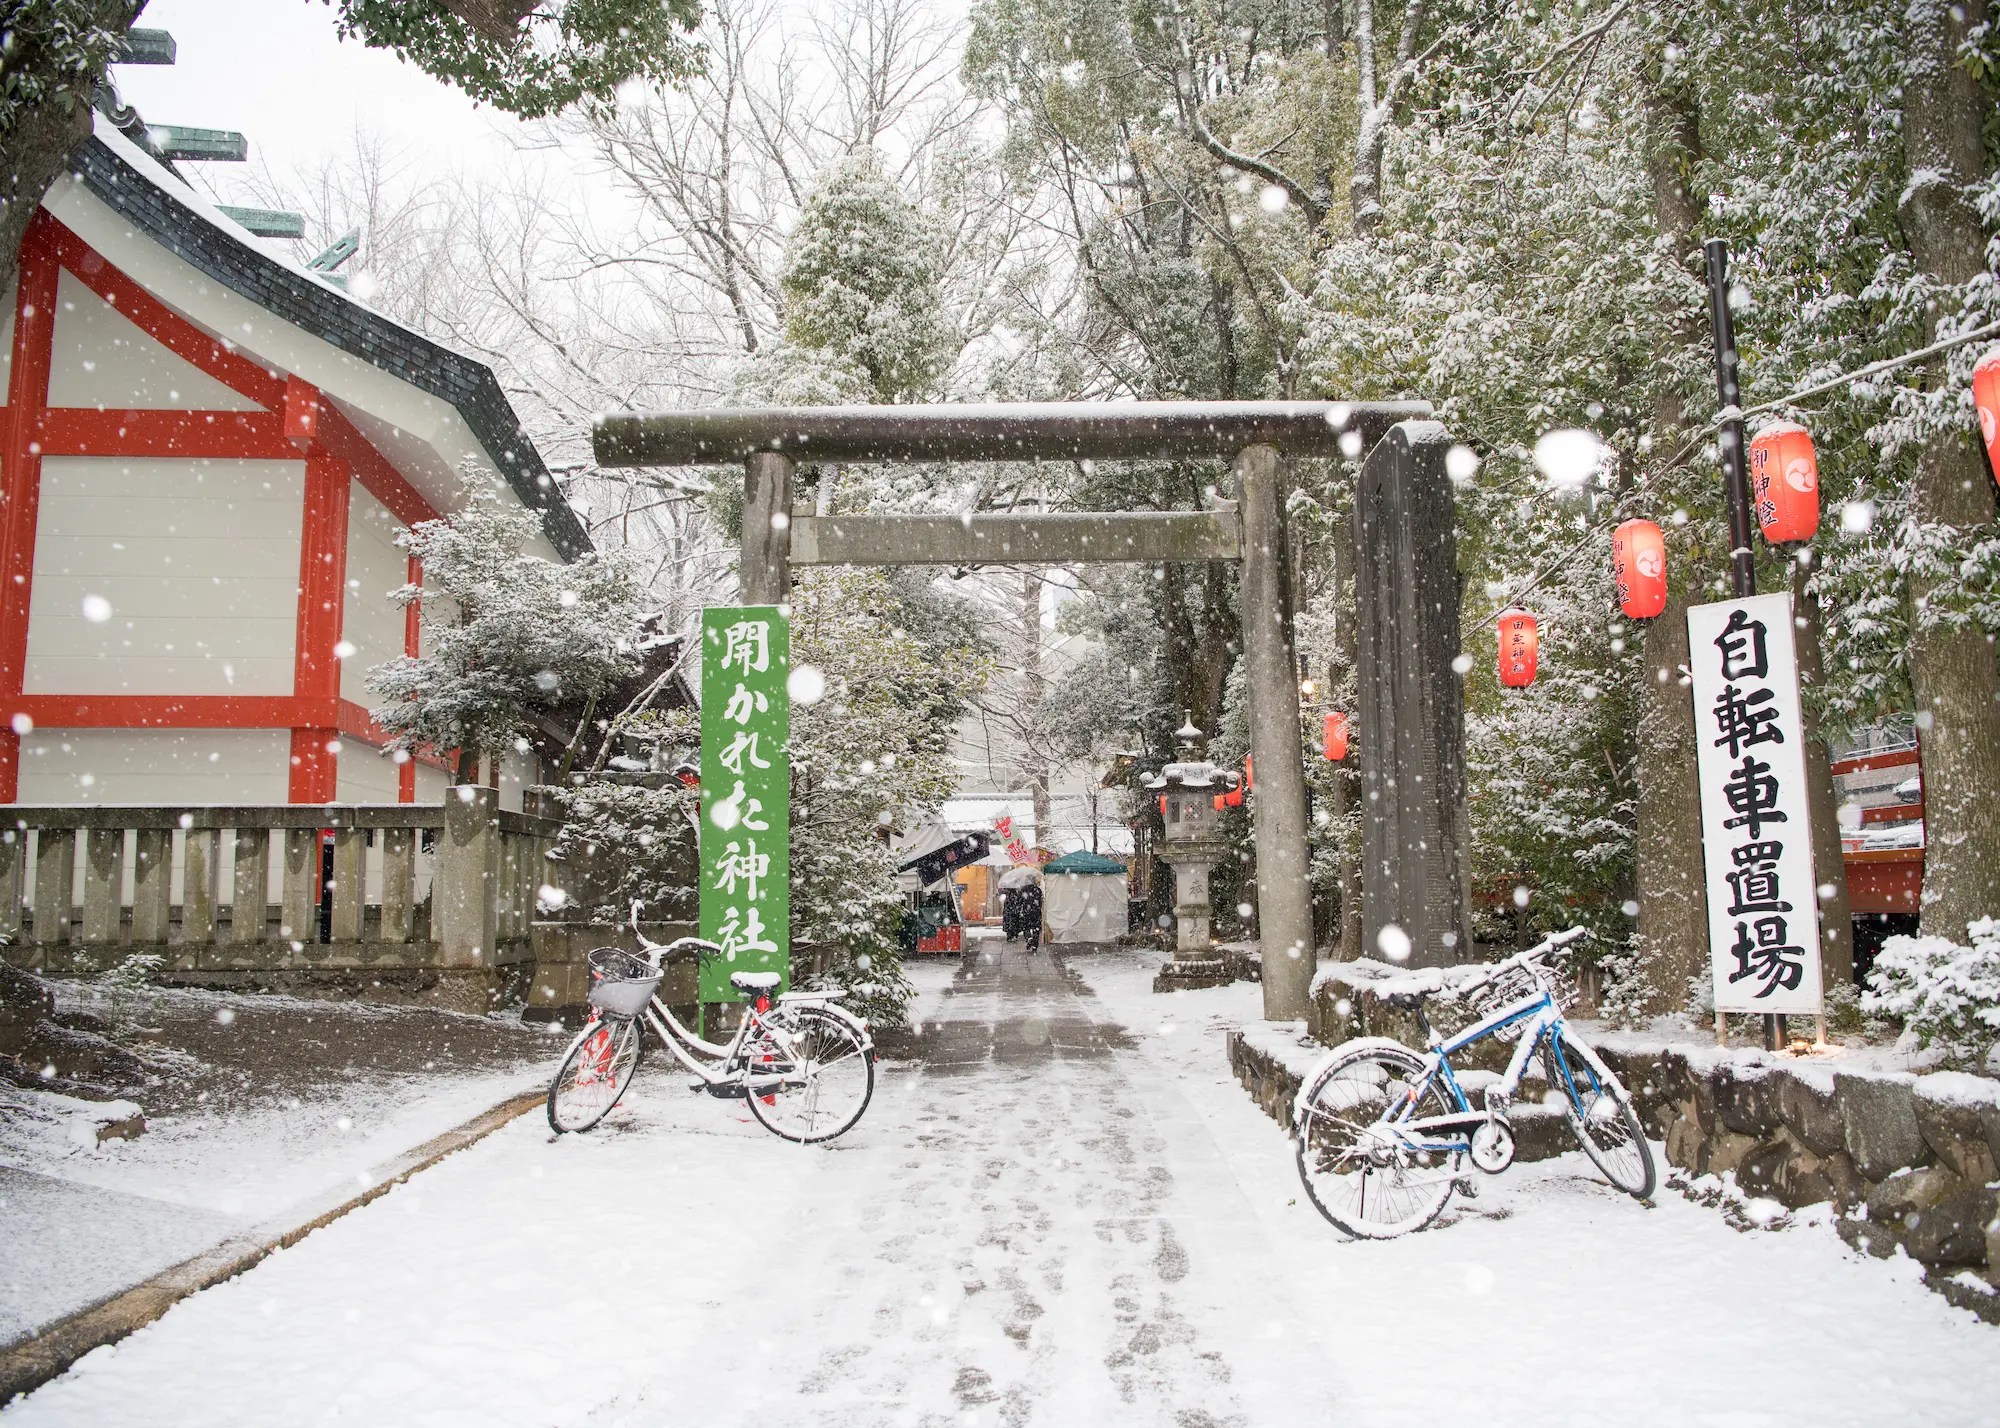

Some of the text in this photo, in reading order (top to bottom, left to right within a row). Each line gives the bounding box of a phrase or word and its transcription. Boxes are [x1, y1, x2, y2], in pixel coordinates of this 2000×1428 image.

[713, 620, 779, 962] 開かれた神社
[1512, 621, 1525, 673] 田無神社
[1713, 609, 1805, 999] 自転車置場
